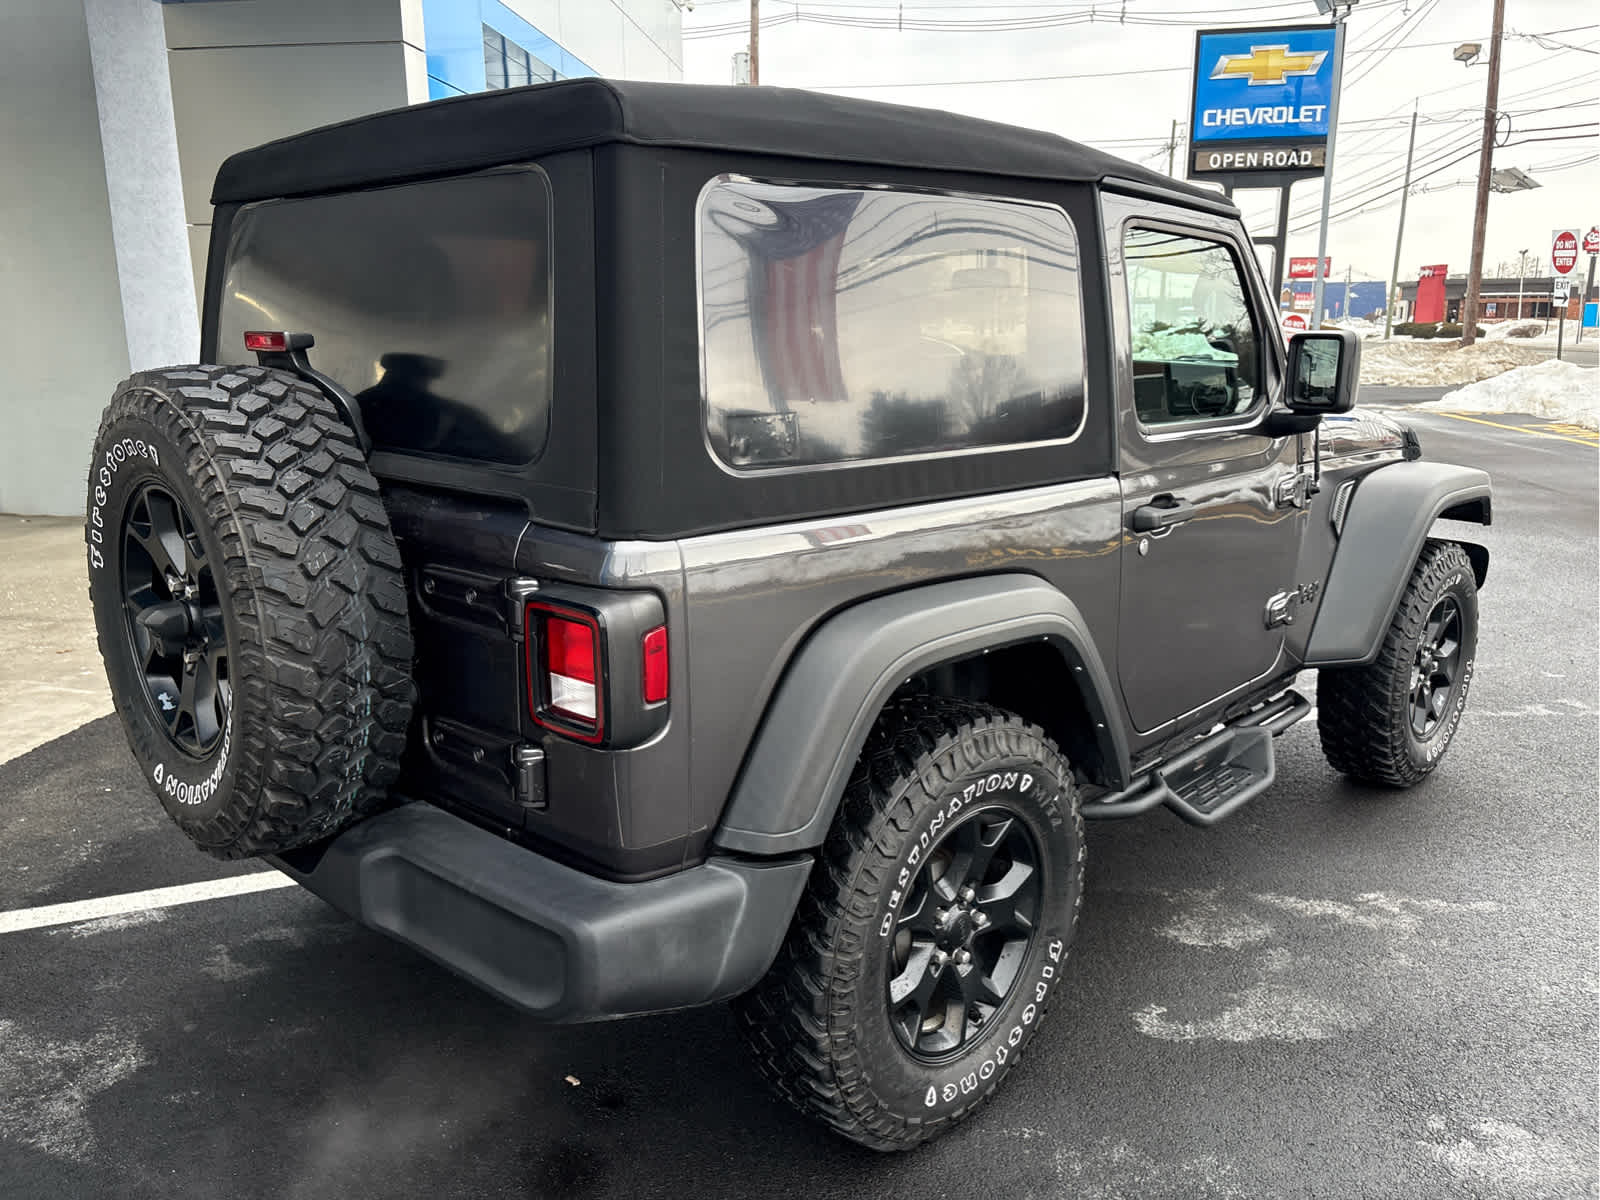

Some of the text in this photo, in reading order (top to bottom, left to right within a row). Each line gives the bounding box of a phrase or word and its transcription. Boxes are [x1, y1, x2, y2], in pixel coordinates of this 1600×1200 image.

[1203, 105, 1327, 127] CHEVROLET
[1209, 150, 1313, 169] OPEN ROAD
[1556, 240, 1564, 249] DO
[1564, 240, 1576, 249] NOT
[1555, 257, 1573, 266] ENTER
[1555, 281, 1570, 290] EXIT
[879, 772, 1019, 937] DESTINATION
